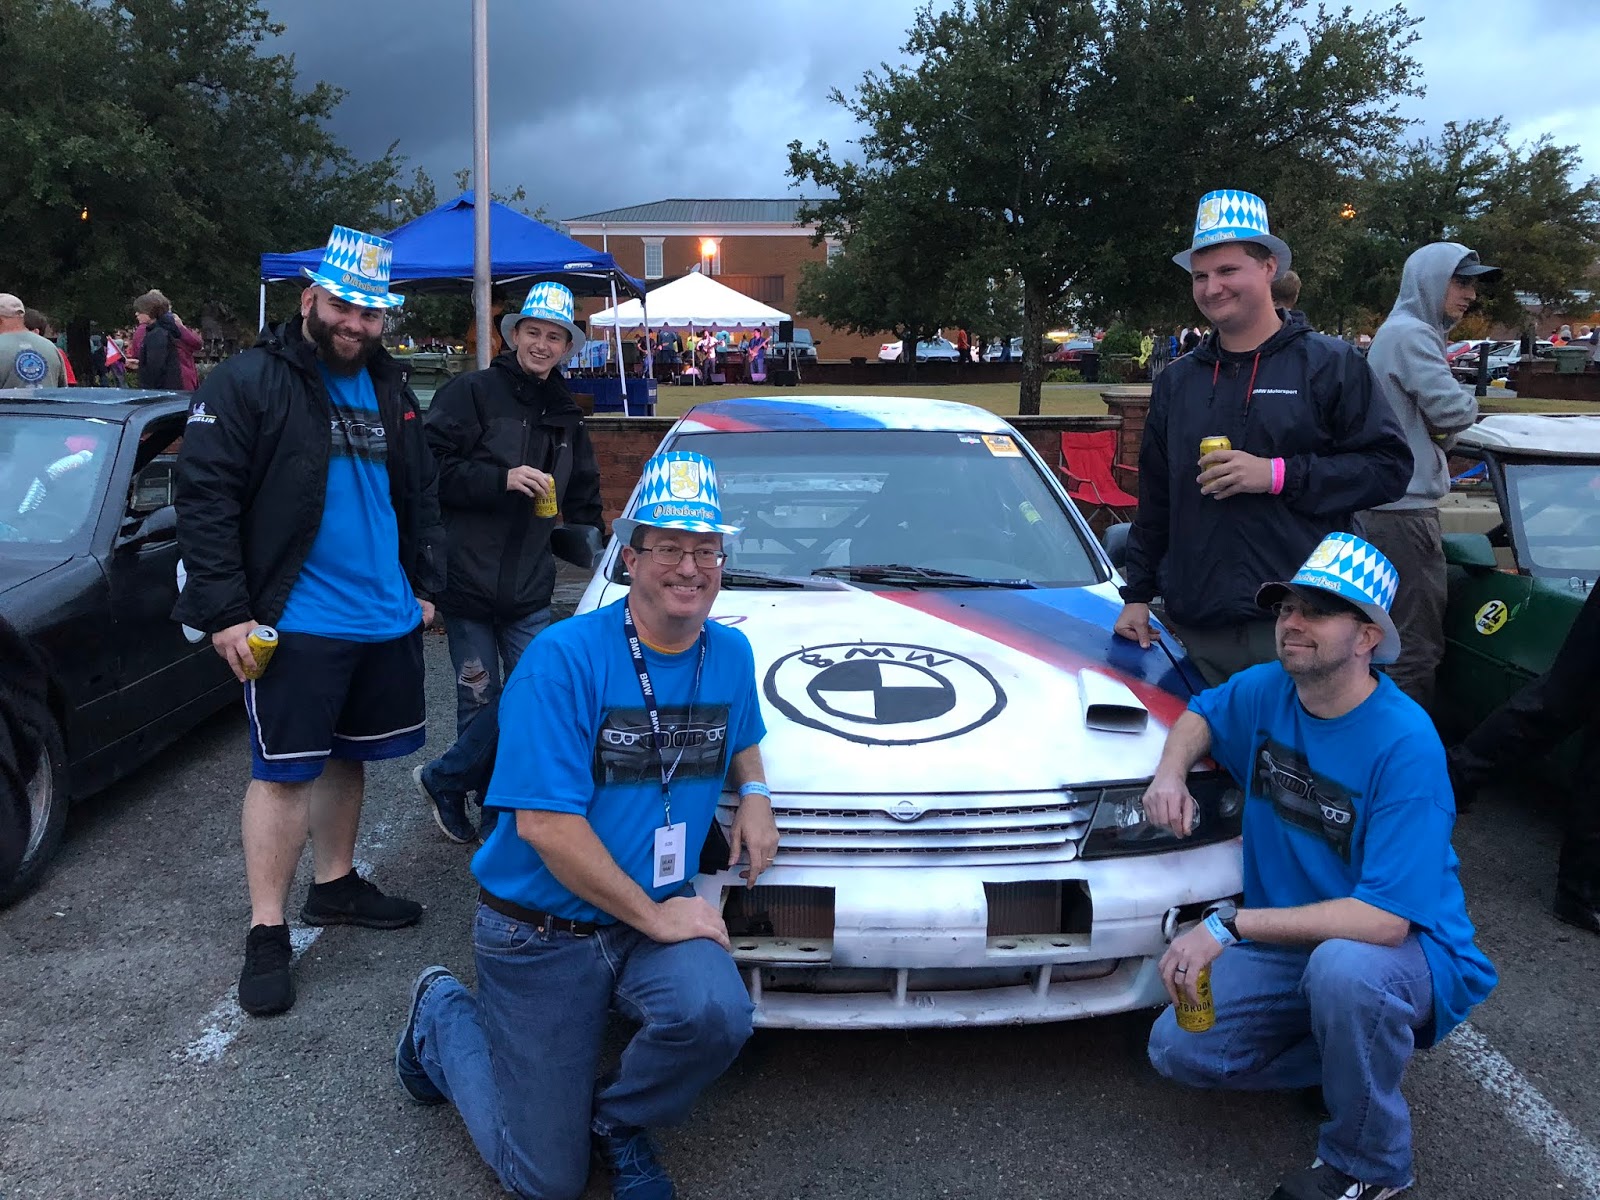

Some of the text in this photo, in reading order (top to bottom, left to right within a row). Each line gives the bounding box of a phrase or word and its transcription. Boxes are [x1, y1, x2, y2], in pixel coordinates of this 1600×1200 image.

[624, 607, 633, 625] BMW
[1482, 602, 1505, 625] 24
[629, 637, 642, 659] BMW
[798, 645, 954, 669] BMW
[639, 672, 653, 696] BMW
[649, 709, 660, 734] BMW
